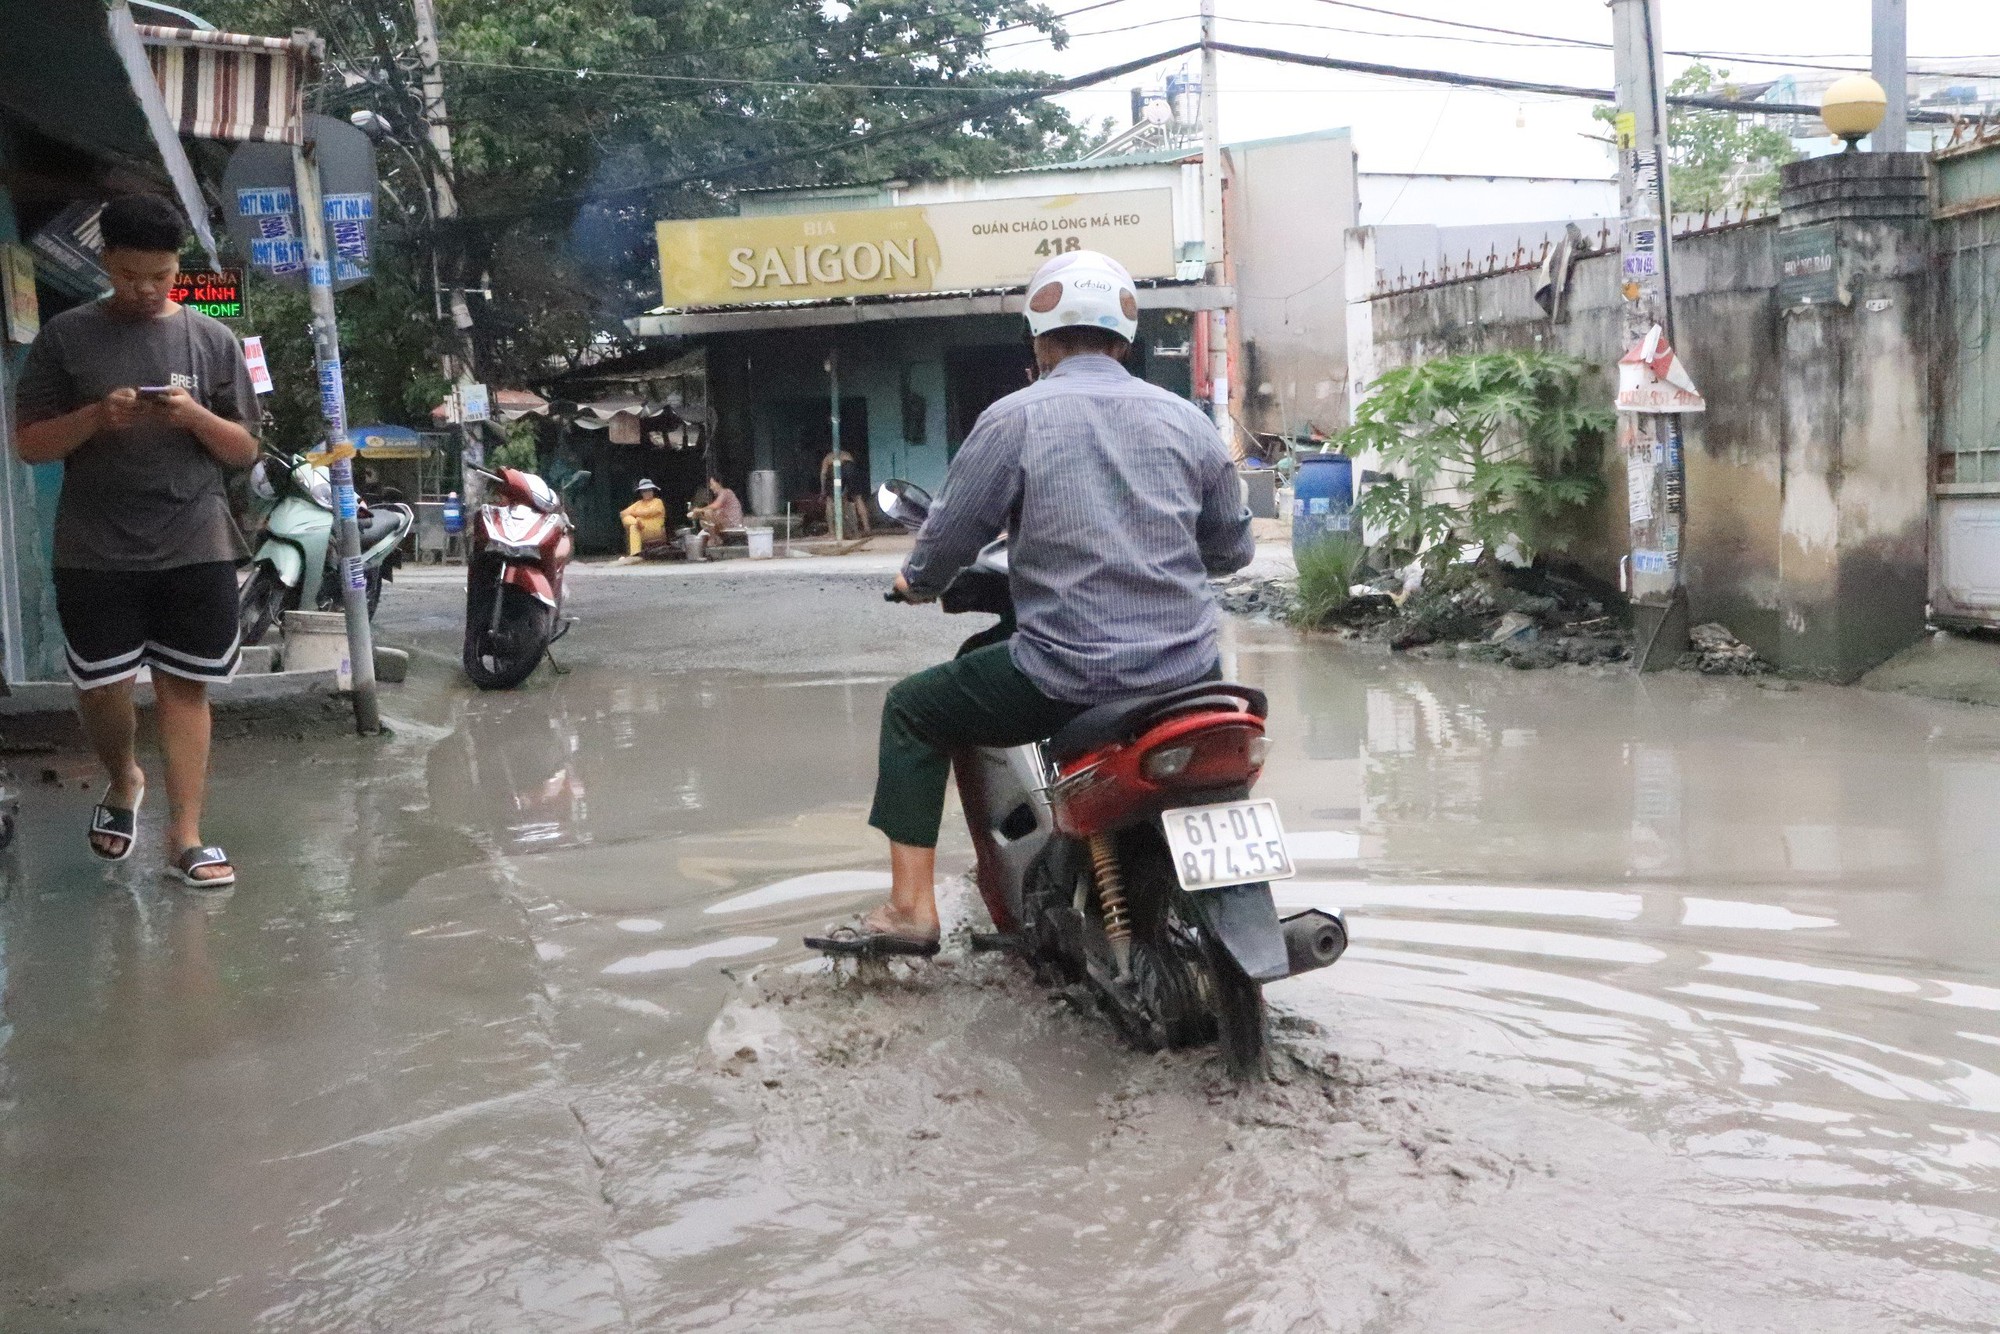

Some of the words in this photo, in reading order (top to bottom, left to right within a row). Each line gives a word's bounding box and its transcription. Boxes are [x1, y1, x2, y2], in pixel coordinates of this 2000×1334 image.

[803, 219, 837, 237] BIA
[971, 222, 1009, 236] QUÁN
[1012, 217, 1049, 233] CHÁO
[1051, 215, 1088, 231] LÒNG
[1090, 213, 1111, 227] MÁ
[1113, 213, 1141, 226] HEO
[1034, 235, 1082, 257] 418
[727, 237, 918, 289] SAIGON
[194, 284, 236, 301] KÍNH
[1183, 806, 1263, 846] 61-D1
[1182, 840, 1287, 886] 874.55
